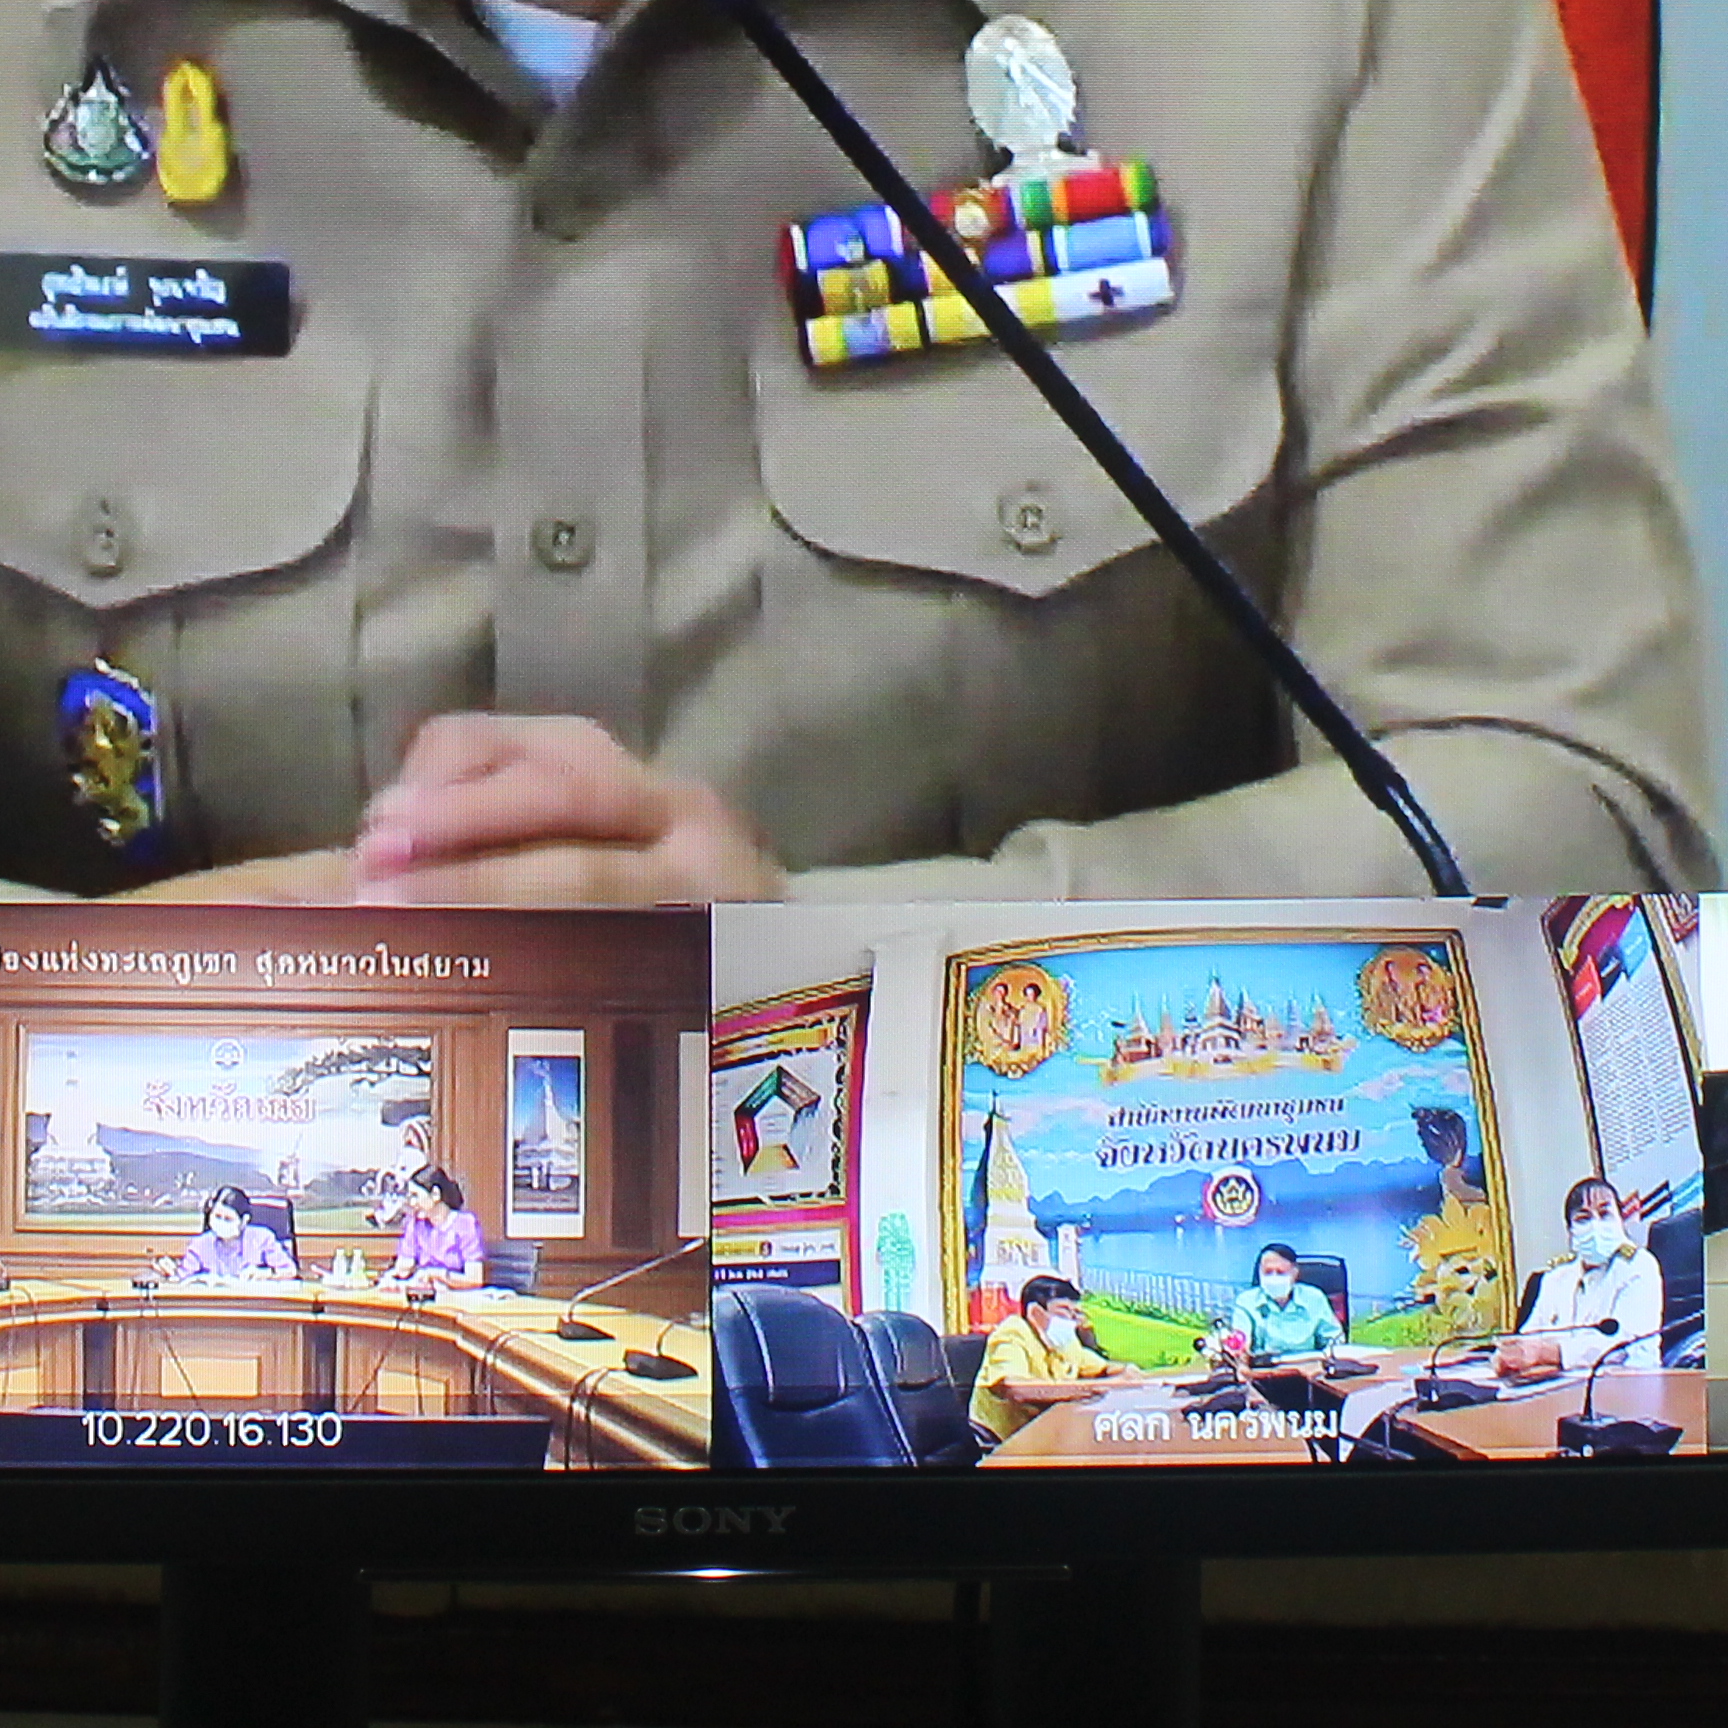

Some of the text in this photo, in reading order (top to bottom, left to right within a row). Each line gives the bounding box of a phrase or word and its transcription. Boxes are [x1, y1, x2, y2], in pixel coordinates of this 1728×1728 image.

[255, 941, 491, 987] สุดหนาวในสยาม
[81, 1410, 343, 1447] 10.220.16.130
[1093, 1409, 1339, 1442] ศลก นครพนม
[634, 1506, 797, 1535] SONY
